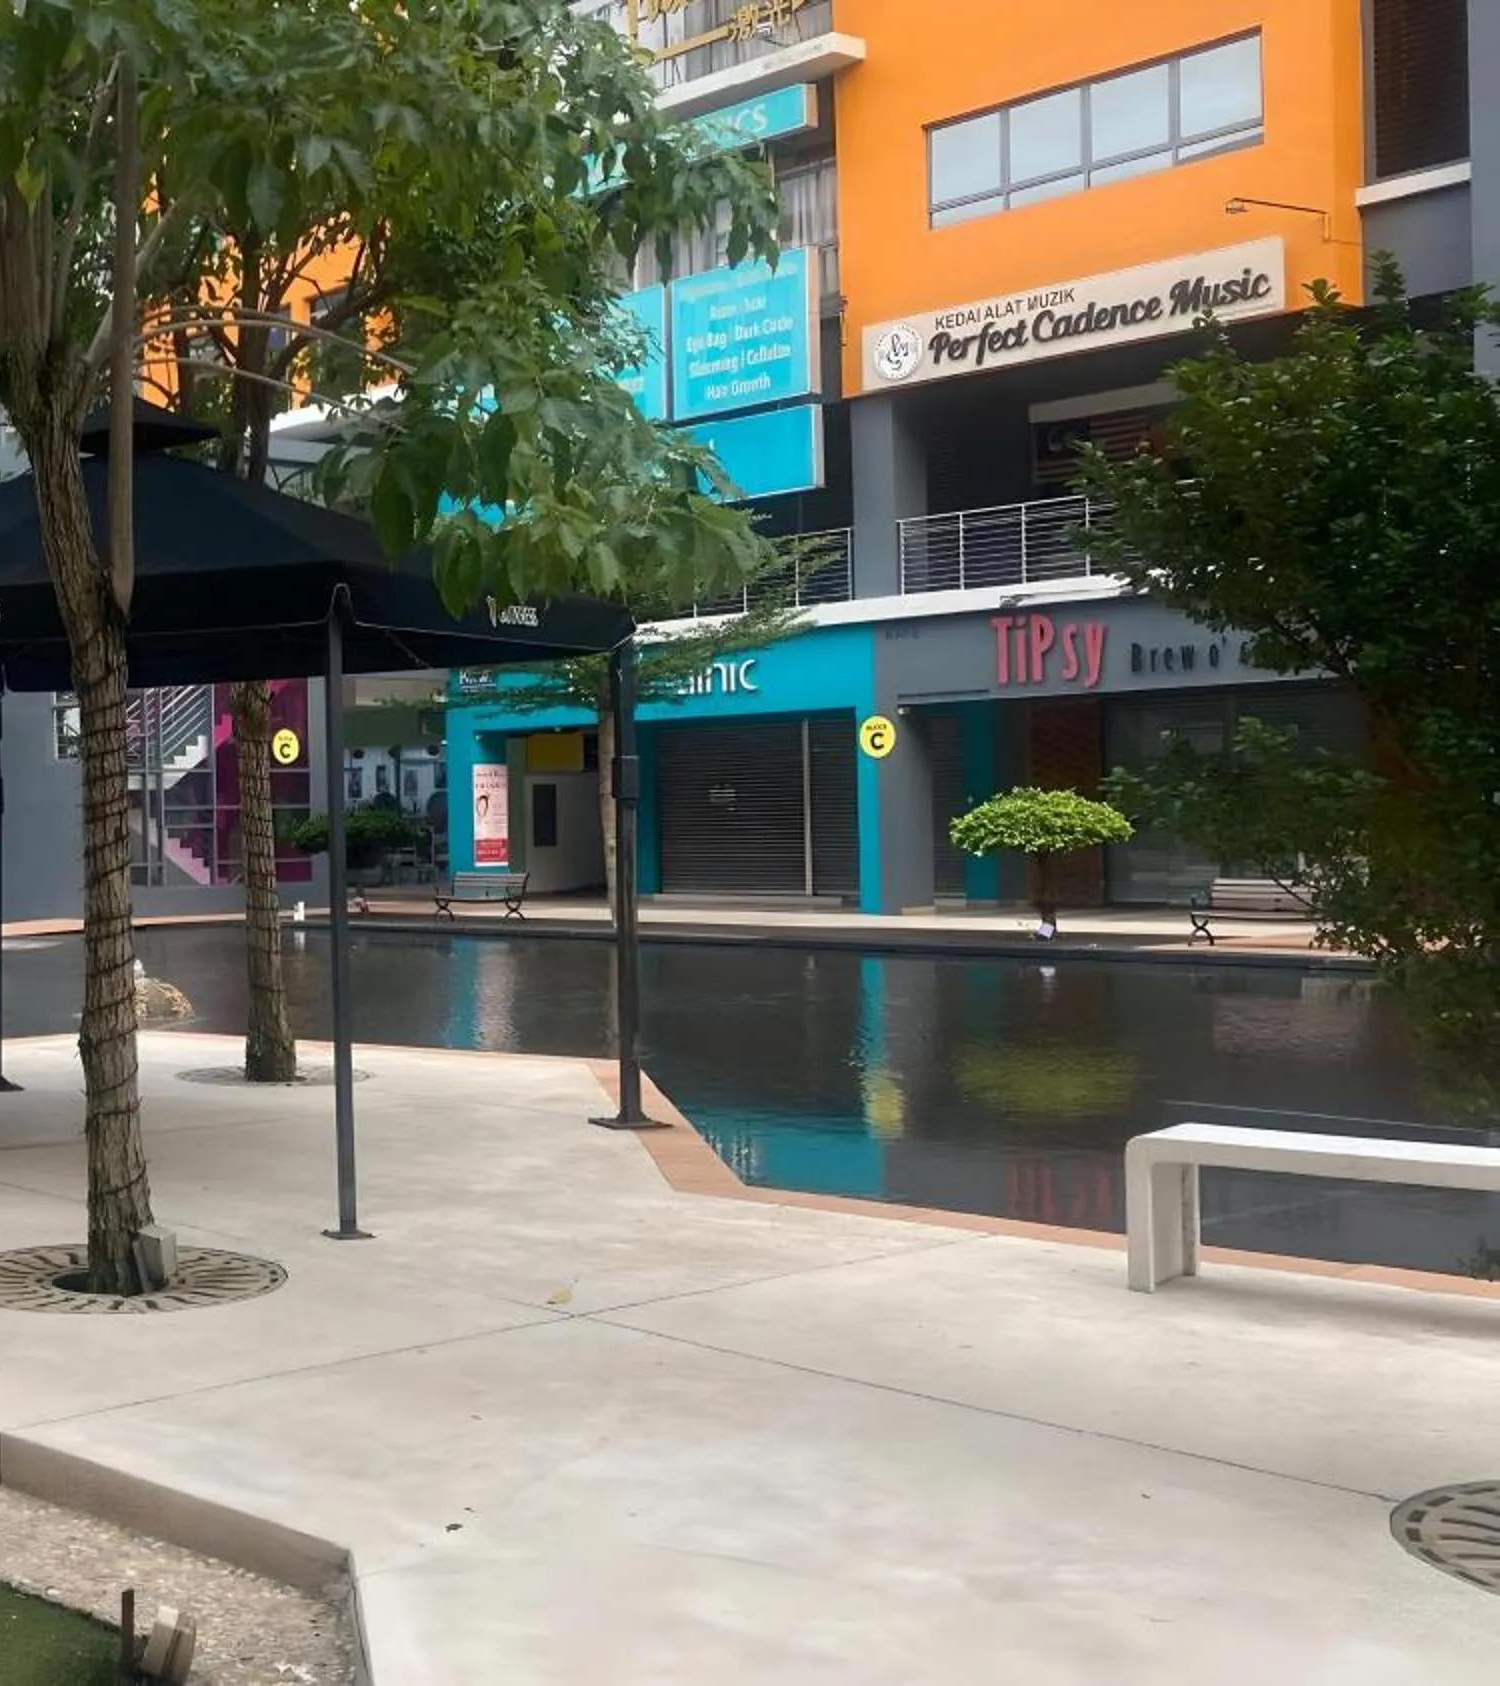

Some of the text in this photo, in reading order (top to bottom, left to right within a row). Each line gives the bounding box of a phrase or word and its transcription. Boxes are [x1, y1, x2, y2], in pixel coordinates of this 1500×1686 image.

[928, 319, 1030, 366] Perfect
[1031, 295, 1164, 343] Cadence
[1169, 267, 1272, 317] Music
[935, 288, 1076, 331] KEDAI ALAT MUZIK
[280, 743, 292, 759] C
[870, 732, 885, 750] C
